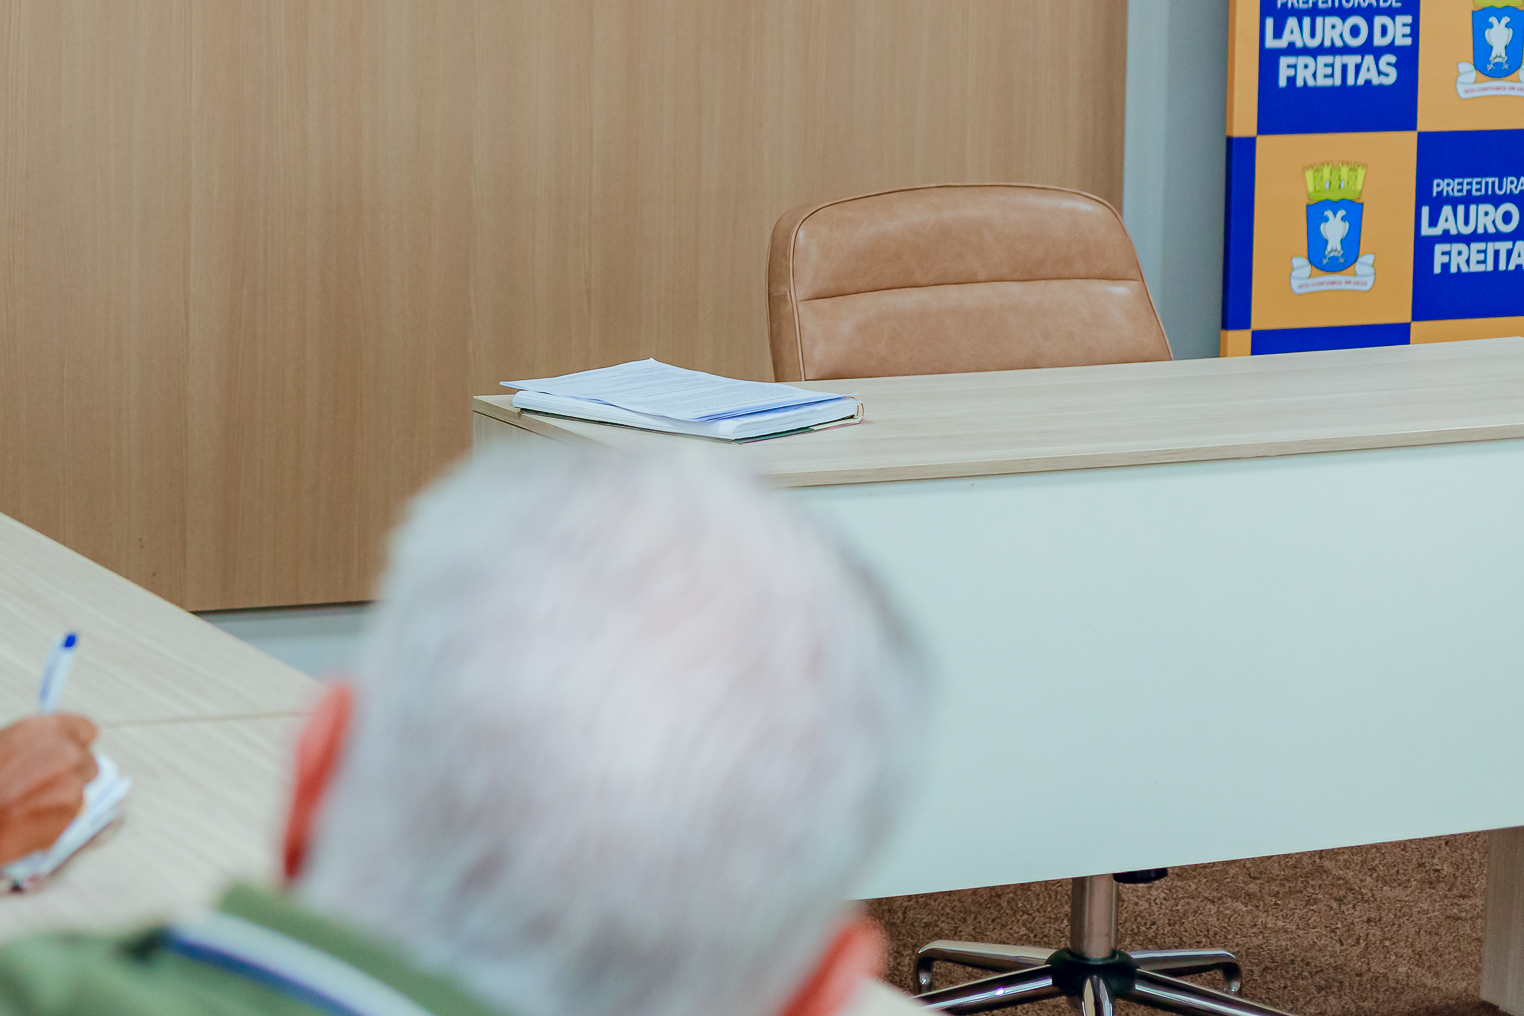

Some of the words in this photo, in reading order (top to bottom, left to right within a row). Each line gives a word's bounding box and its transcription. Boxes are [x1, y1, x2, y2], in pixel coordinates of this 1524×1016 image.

[1266, 16, 1368, 47] LAURO
[1374, 16, 1412, 45] DE
[1279, 55, 1396, 87] FREITAS
[1422, 203, 1519, 235] LAURO
[1434, 241, 1524, 273] FREITA
